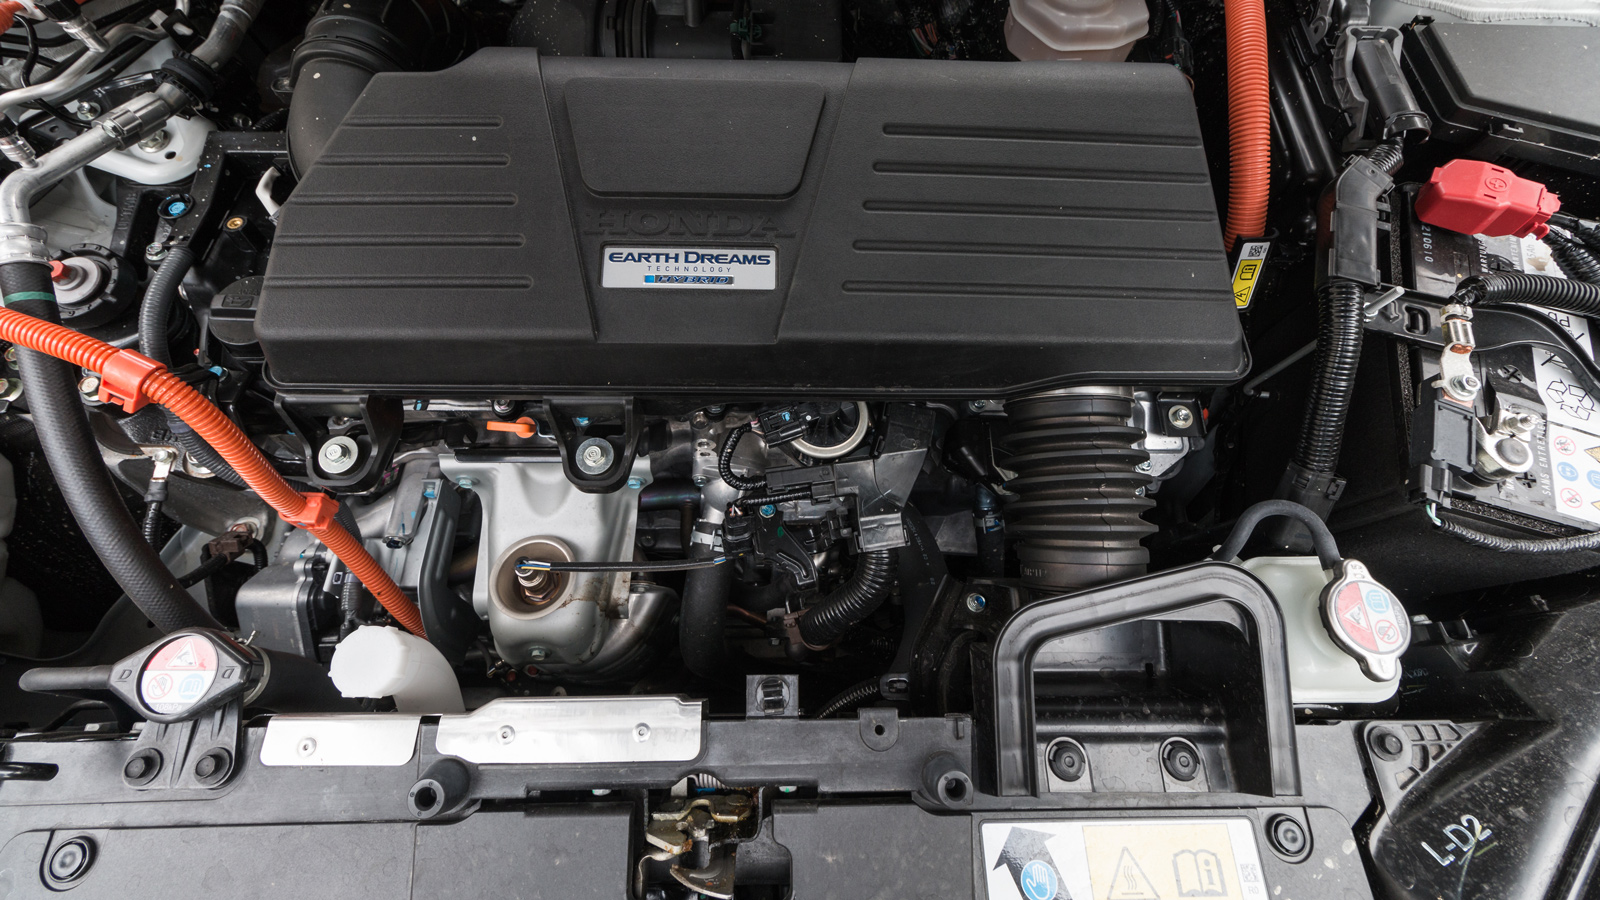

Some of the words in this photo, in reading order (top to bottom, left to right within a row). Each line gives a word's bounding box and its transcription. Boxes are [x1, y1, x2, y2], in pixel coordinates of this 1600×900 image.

[583, 209, 797, 238] HONDA
[608, 251, 680, 264] EARTH
[683, 250, 771, 265] DREAMS
[1478, 236, 1489, 273] WARTUNG
[1510, 236, 1521, 271] MANTENIM
[647, 265, 732, 273] TECHNOLOGY
[657, 275, 730, 284] HYBRID
[1537, 419, 1549, 468] ENTRETIEN
[1540, 473, 1552, 495] SANS
[156, 703, 183, 711] 108kPa
[1421, 814, 1493, 867] L-D2
